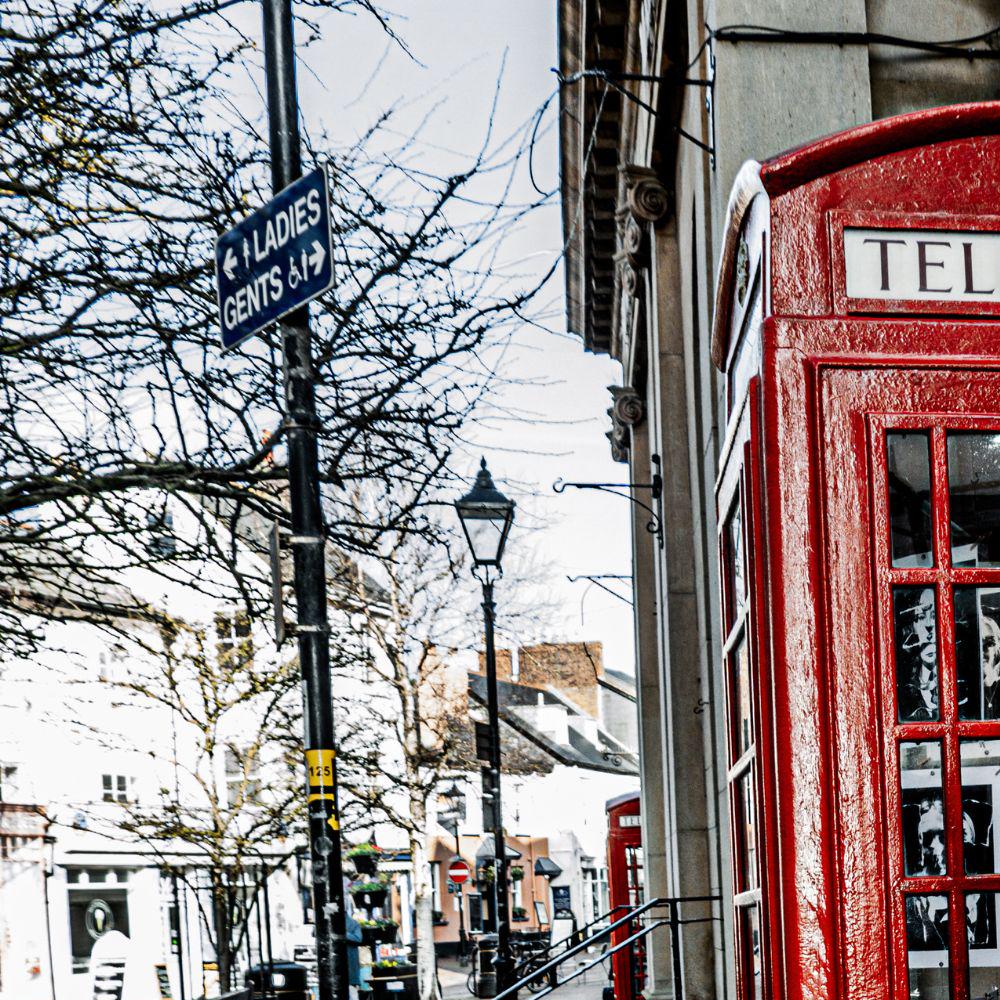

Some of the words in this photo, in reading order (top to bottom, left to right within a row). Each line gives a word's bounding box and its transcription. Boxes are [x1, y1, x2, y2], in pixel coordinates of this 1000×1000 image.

[253, 188, 321, 263] LADIES
[223, 265, 283, 330] GENTS
[309, 766, 331, 777] 125
